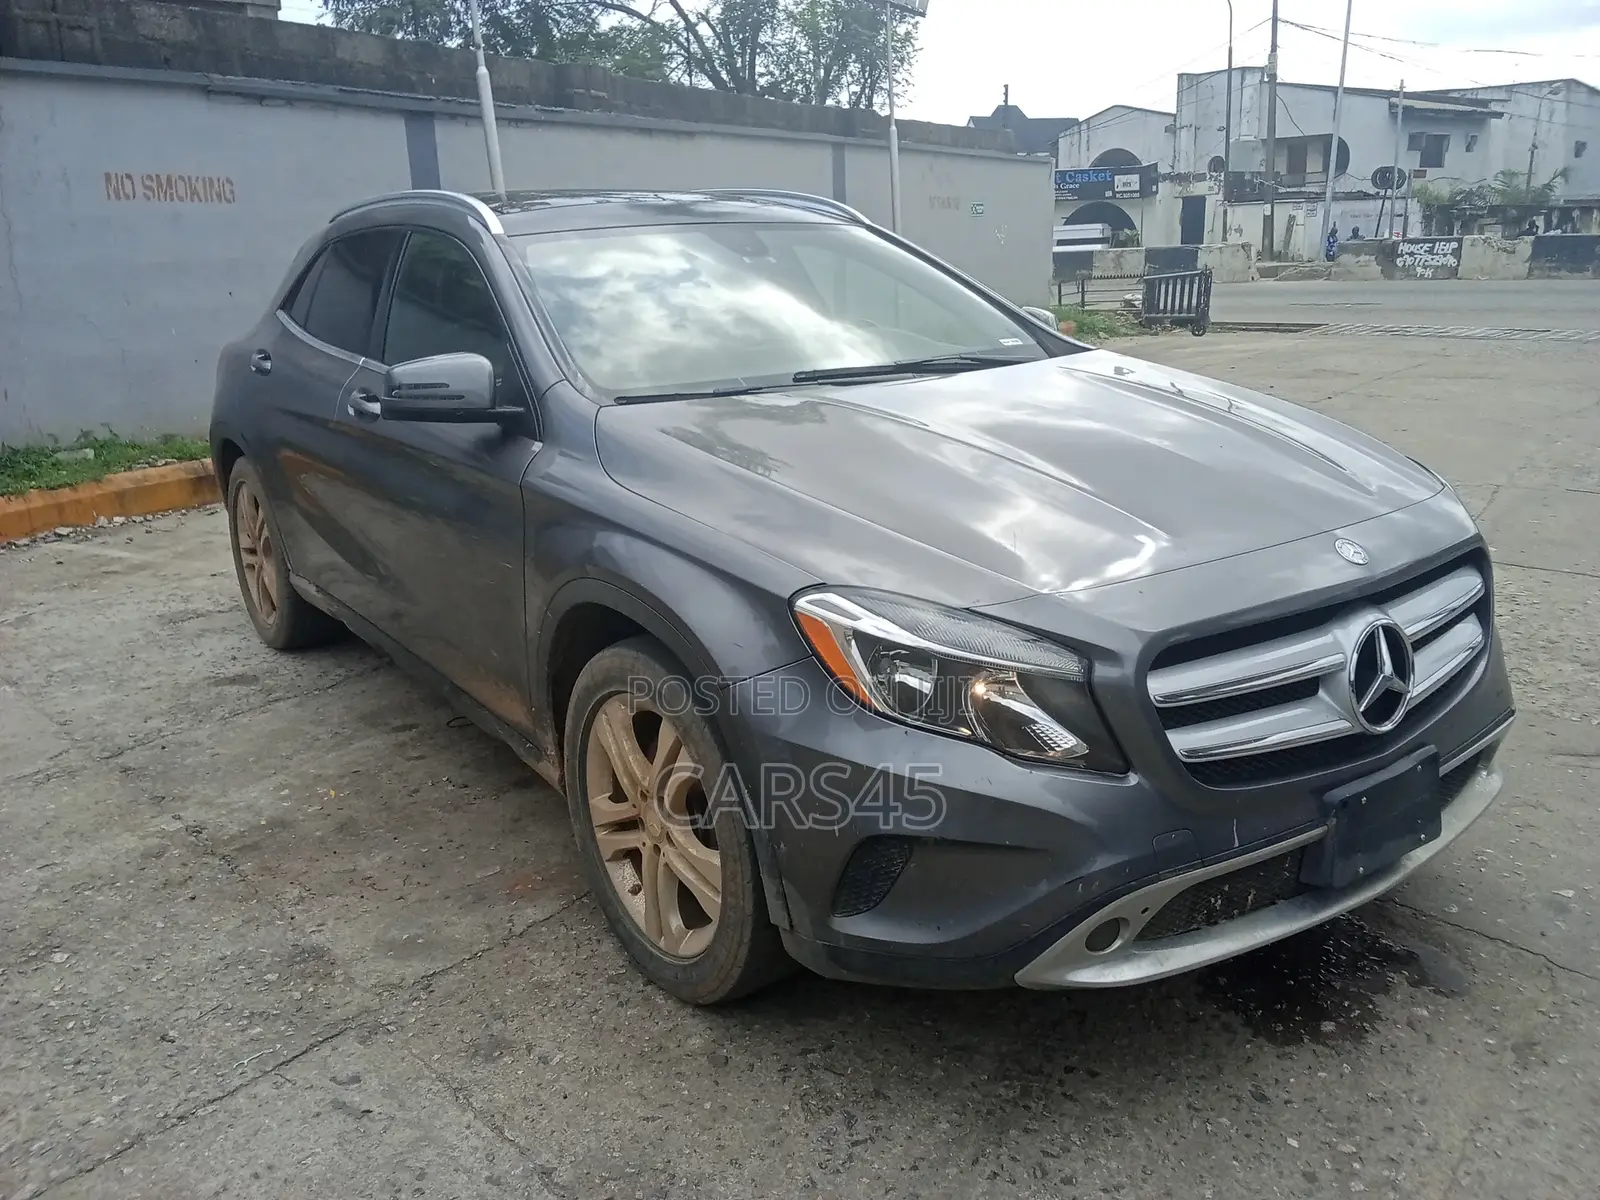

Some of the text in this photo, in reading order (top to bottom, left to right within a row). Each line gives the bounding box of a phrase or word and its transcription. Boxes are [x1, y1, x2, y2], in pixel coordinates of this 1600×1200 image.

[1065, 170, 1113, 183] Casket
[104, 172, 236, 204] NO SMOKING
[1060, 182, 1080, 190] Grace
[1397, 241, 1433, 255] HOUSE
